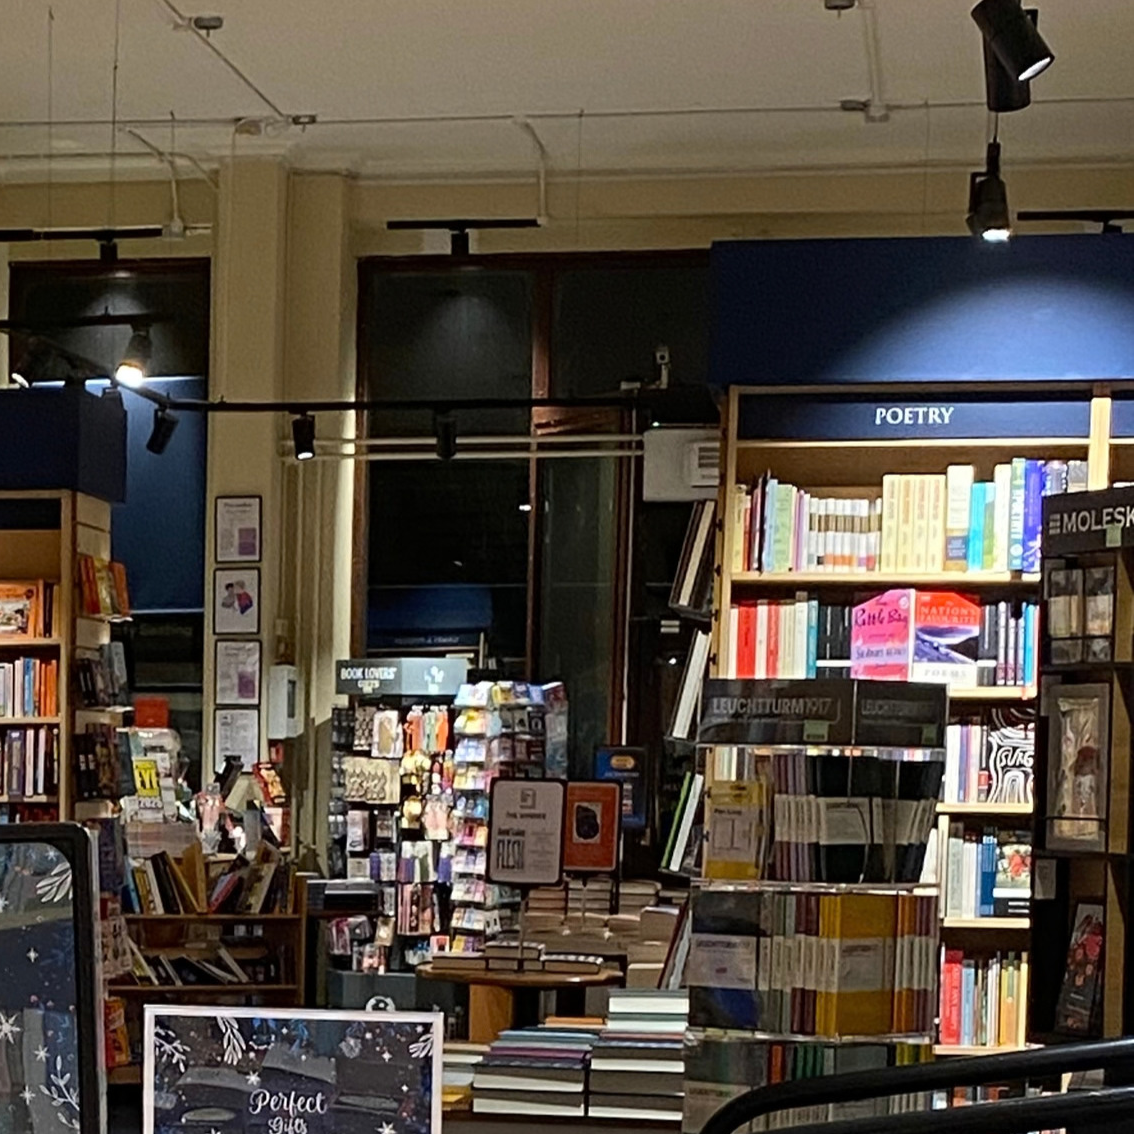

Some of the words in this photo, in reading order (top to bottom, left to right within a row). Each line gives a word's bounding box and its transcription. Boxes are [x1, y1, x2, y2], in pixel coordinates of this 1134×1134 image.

[875, 407, 954, 425] POETRY
[340, 667, 364, 680] BOOK
[249, 1088, 328, 1116] Perfect
